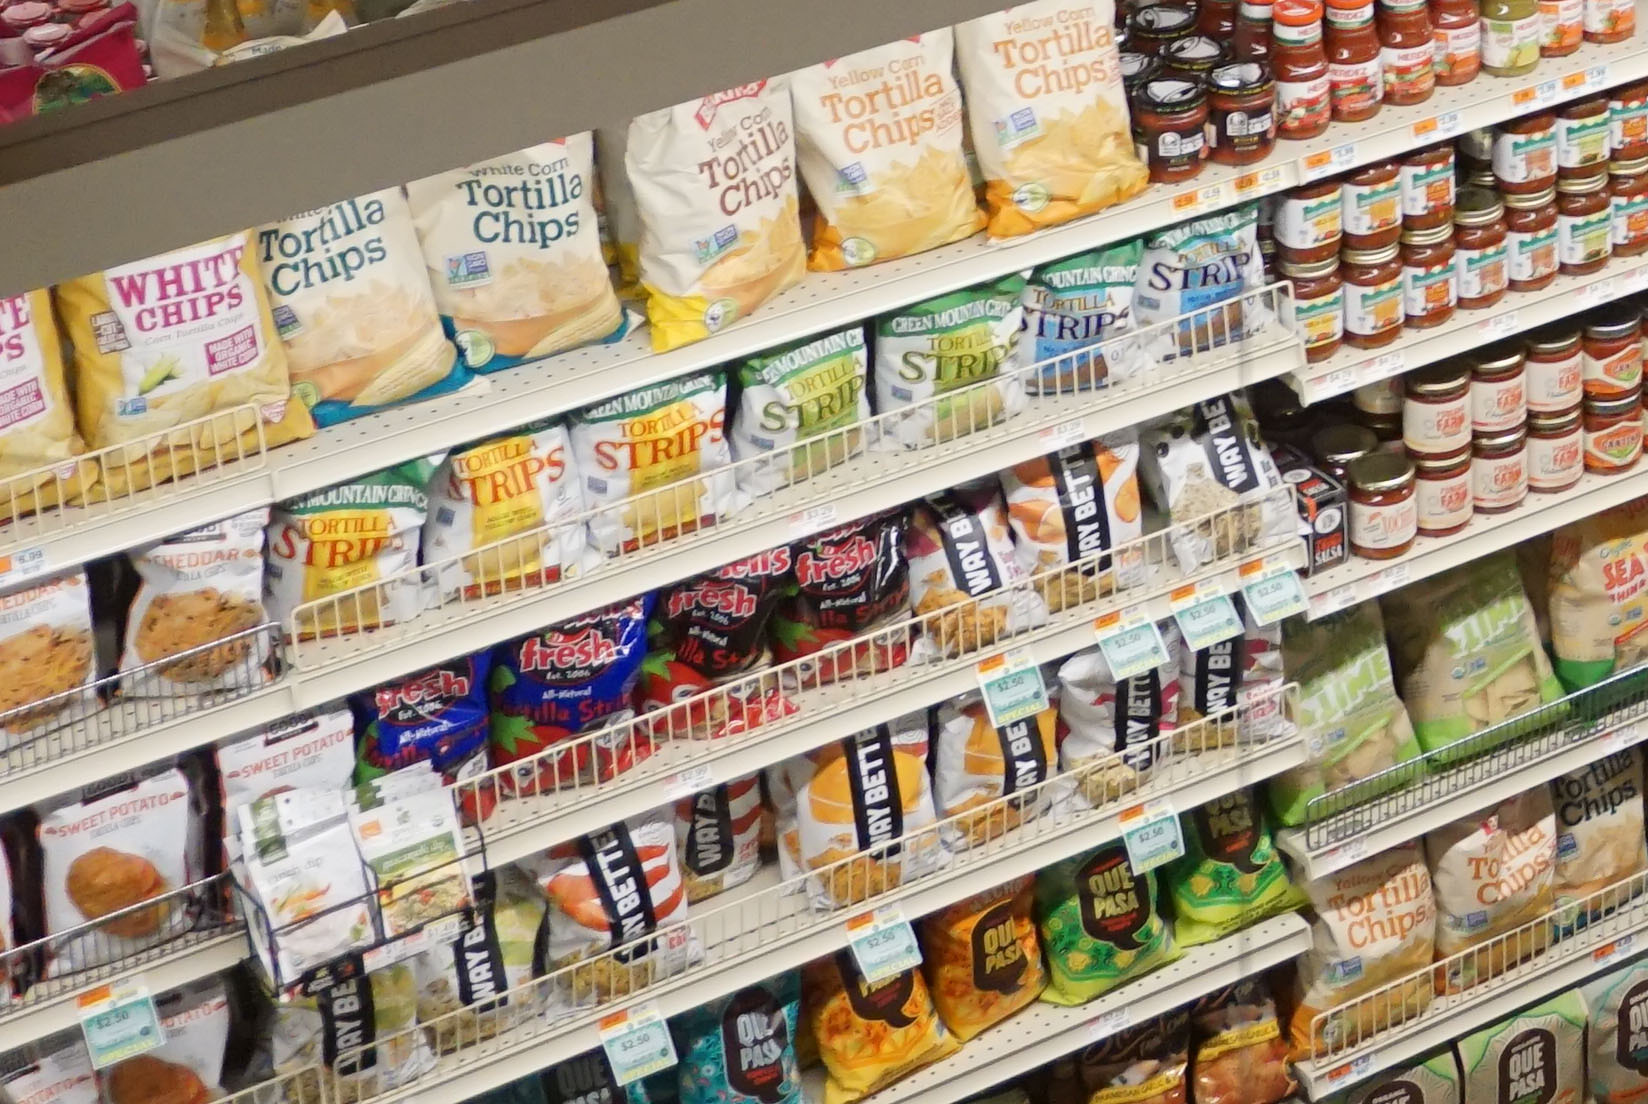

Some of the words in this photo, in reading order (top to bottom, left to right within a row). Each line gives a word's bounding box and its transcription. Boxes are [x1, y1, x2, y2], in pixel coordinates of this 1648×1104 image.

[1004, 14, 1052, 35] Yellow
[1056, 6, 1095, 26] Corn
[1329, 11, 1364, 21] HERDEZ
[994, 21, 1112, 69] Tortilla
[1397, 52, 1428, 62] HERDEZ
[827, 66, 885, 89] Yellow
[1015, 52, 1109, 99] Chips
[820, 73, 945, 125] Tortilla
[844, 105, 936, 154] Chips
[524, 156, 570, 176] Corn
[700, 118, 789, 189] Tortilla
[457, 168, 582, 209] Tortilla
[719, 156, 792, 216] Chips
[260, 196, 386, 263] Tortilla
[473, 209, 580, 249] Chips
[272, 235, 387, 296] Chips
[1147, 252, 1254, 292] STRIP
[134, 291, 243, 332] CHIPS
[1032, 289, 1115, 310] TORTILLA
[787, 357, 863, 400] TORTILLA
[618, 402, 704, 438] TORTILLA
[764, 375, 865, 432] STRIP
[595, 412, 727, 472] STRIPS
[1212, 432, 1248, 489] WAY
[300, 516, 398, 537] TORTILLA
[796, 538, 876, 585] fresh
[1603, 558, 1642, 591] SEA
[668, 584, 757, 618] fresh
[520, 634, 617, 670] fresh
[242, 753, 289, 779] SWEET
[292, 733, 346, 764] POTATO
[58, 814, 102, 838] SWEET
[105, 794, 169, 822] POTATO
[1559, 779, 1638, 829] Chips
[701, 821, 720, 865] WAY
[1088, 863, 1134, 897] QUE
[1328, 871, 1431, 923] Tortilla
[1476, 855, 1551, 908] Chips
[1094, 890, 1139, 923] PASA
[1348, 902, 1427, 950] Chips
[1509, 1042, 1544, 1072] QUE
[1510, 1068, 1546, 1100] PASA
